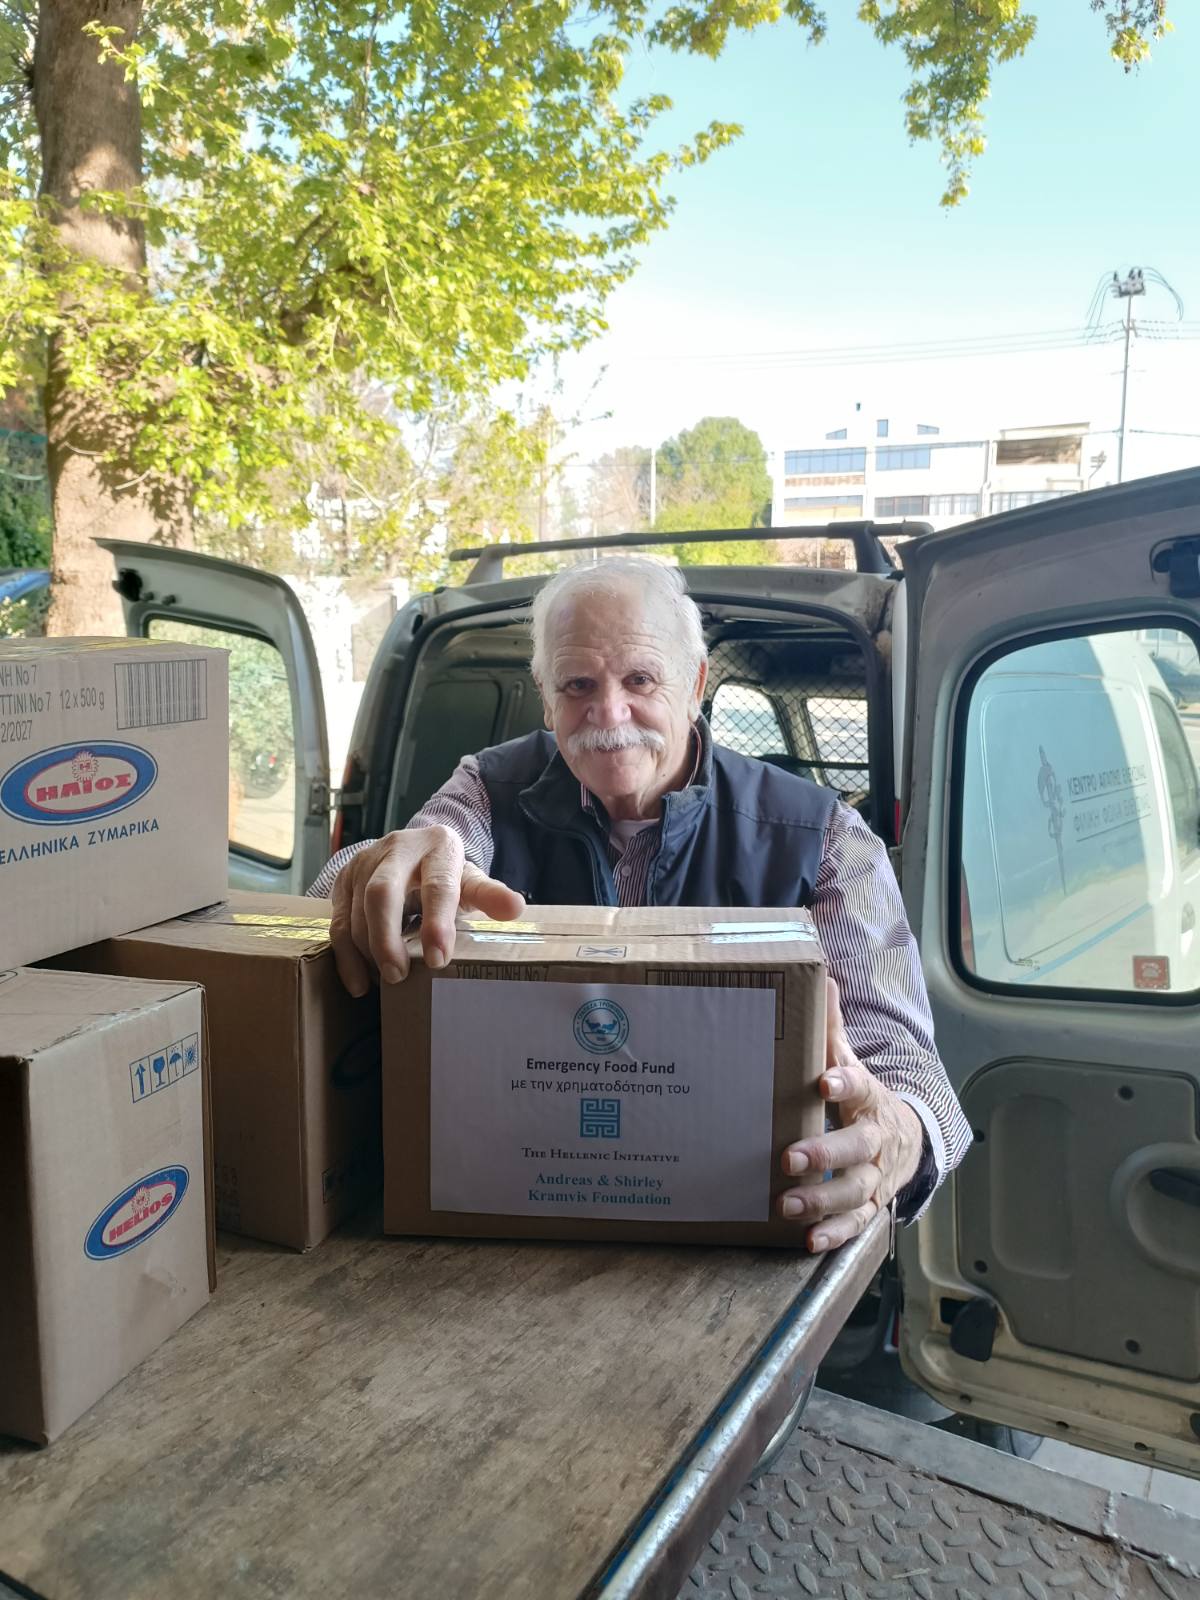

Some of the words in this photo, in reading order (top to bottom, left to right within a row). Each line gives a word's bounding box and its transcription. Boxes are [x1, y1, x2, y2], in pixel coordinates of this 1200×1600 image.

[32, 665, 37, 684] 7
[30, 692, 44, 713] No
[46, 692, 52, 711] 7
[60, 689, 71, 710] 12
[73, 694, 79, 708] x
[81, 687, 97, 708] 500
[99, 691, 105, 711] g
[0, 720, 33, 743] 2/2027
[36, 773, 131, 803] ΗΛΙΟΣ
[0, 835, 79, 865] ΕΛΛΗΝΙΚΑ
[88, 818, 160, 846] ΖΥΜΑΡΙΚΑ
[526, 1058, 601, 1075] Emergency
[604, 1060, 638, 1074] Food
[641, 1061, 676, 1075] Fund
[511, 1079, 527, 1091] με
[530, 1080, 553, 1092] την
[555, 1078, 663, 1096] χρηματοδότηση
[667, 1082, 691, 1095] του
[550, 1148, 611, 1161] HELLENIC
[613, 1150, 681, 1163] INITIATIVE
[536, 1172, 593, 1187] Andreas
[597, 1174, 610, 1187] &
[614, 1174, 664, 1191] Shirley
[528, 1189, 588, 1203] Kramvis
[592, 1191, 672, 1206] Foundation
[109, 1192, 174, 1243] HELIOS
